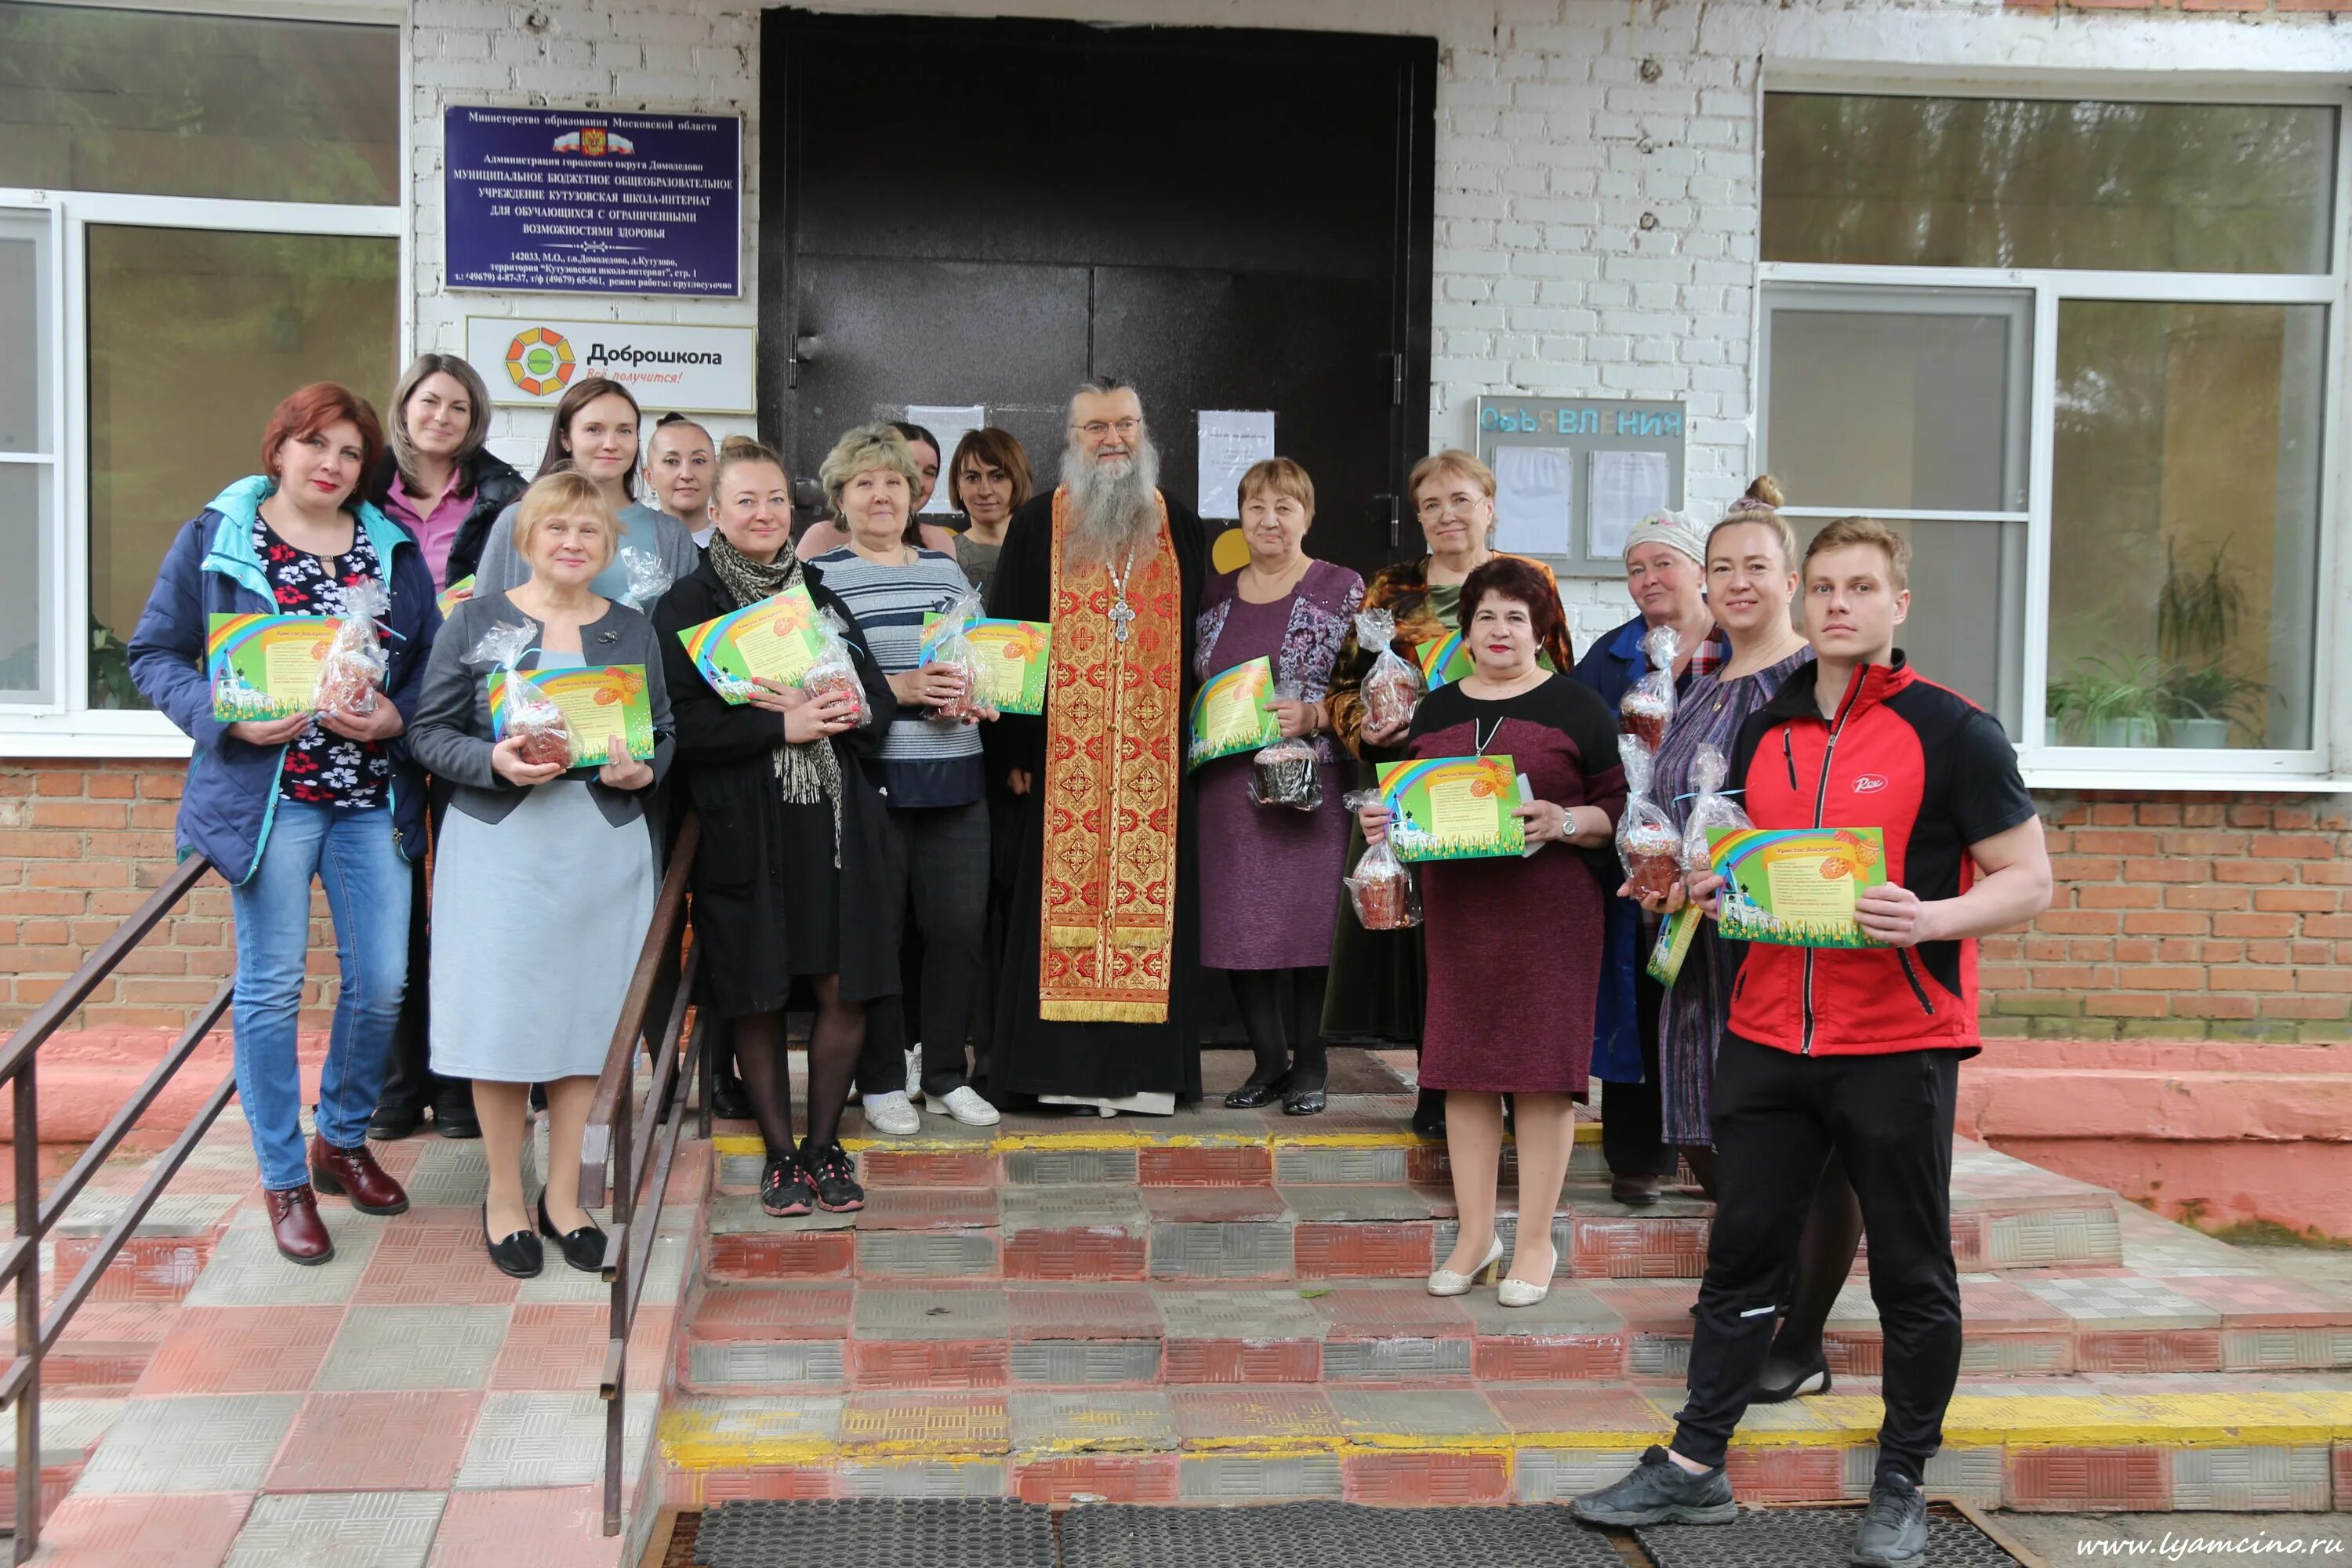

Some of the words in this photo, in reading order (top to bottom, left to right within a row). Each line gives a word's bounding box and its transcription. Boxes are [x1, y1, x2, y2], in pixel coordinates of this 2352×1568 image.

[469, 111, 540, 125] Министерство
[544, 115, 608, 127] образования
[612, 118, 673, 130] Московской
[678, 120, 717, 132] области
[484, 154, 560, 167] Администрация
[562, 158, 613, 169] городского
[615, 161, 647, 171] округа
[649, 161, 703, 172] Домодедово
[453, 169, 543, 182] МУНИЦИПАЛЬНОЕ
[547, 172, 610, 186] БЮДЖЕТНОЕ
[615, 176, 733, 190] ОБЩЕОБРАЗОВАТЕЛЬНОЕ
[478, 187, 545, 201] УЧРЕЖДЕНИЕ
[550, 190, 618, 203] КУТУЗОВСКАЯ
[622, 193, 711, 206] ШКОЛА-ИНТЕРНАТ
[490, 205, 510, 217] ДЛЯ
[514, 206, 593, 220] ОБУЧАЮЩИХСЯ
[597, 209, 605, 220] С
[609, 210, 697, 223] ОГРАНИЧЕННЫМИ
[523, 223, 613, 237] ВОЗМОЖНОСТЯМИ
[618, 227, 665, 239] ЗДОРОВЬЯ
[511, 252, 541, 263] 142033,
[490, 263, 539, 273] территория
[608, 278, 637, 288] режим
[638, 278, 671, 289] работы:
[673, 281, 732, 291] круглосуточно
[586, 343, 722, 367] Доброшкола
[612, 371, 684, 384] получится!
